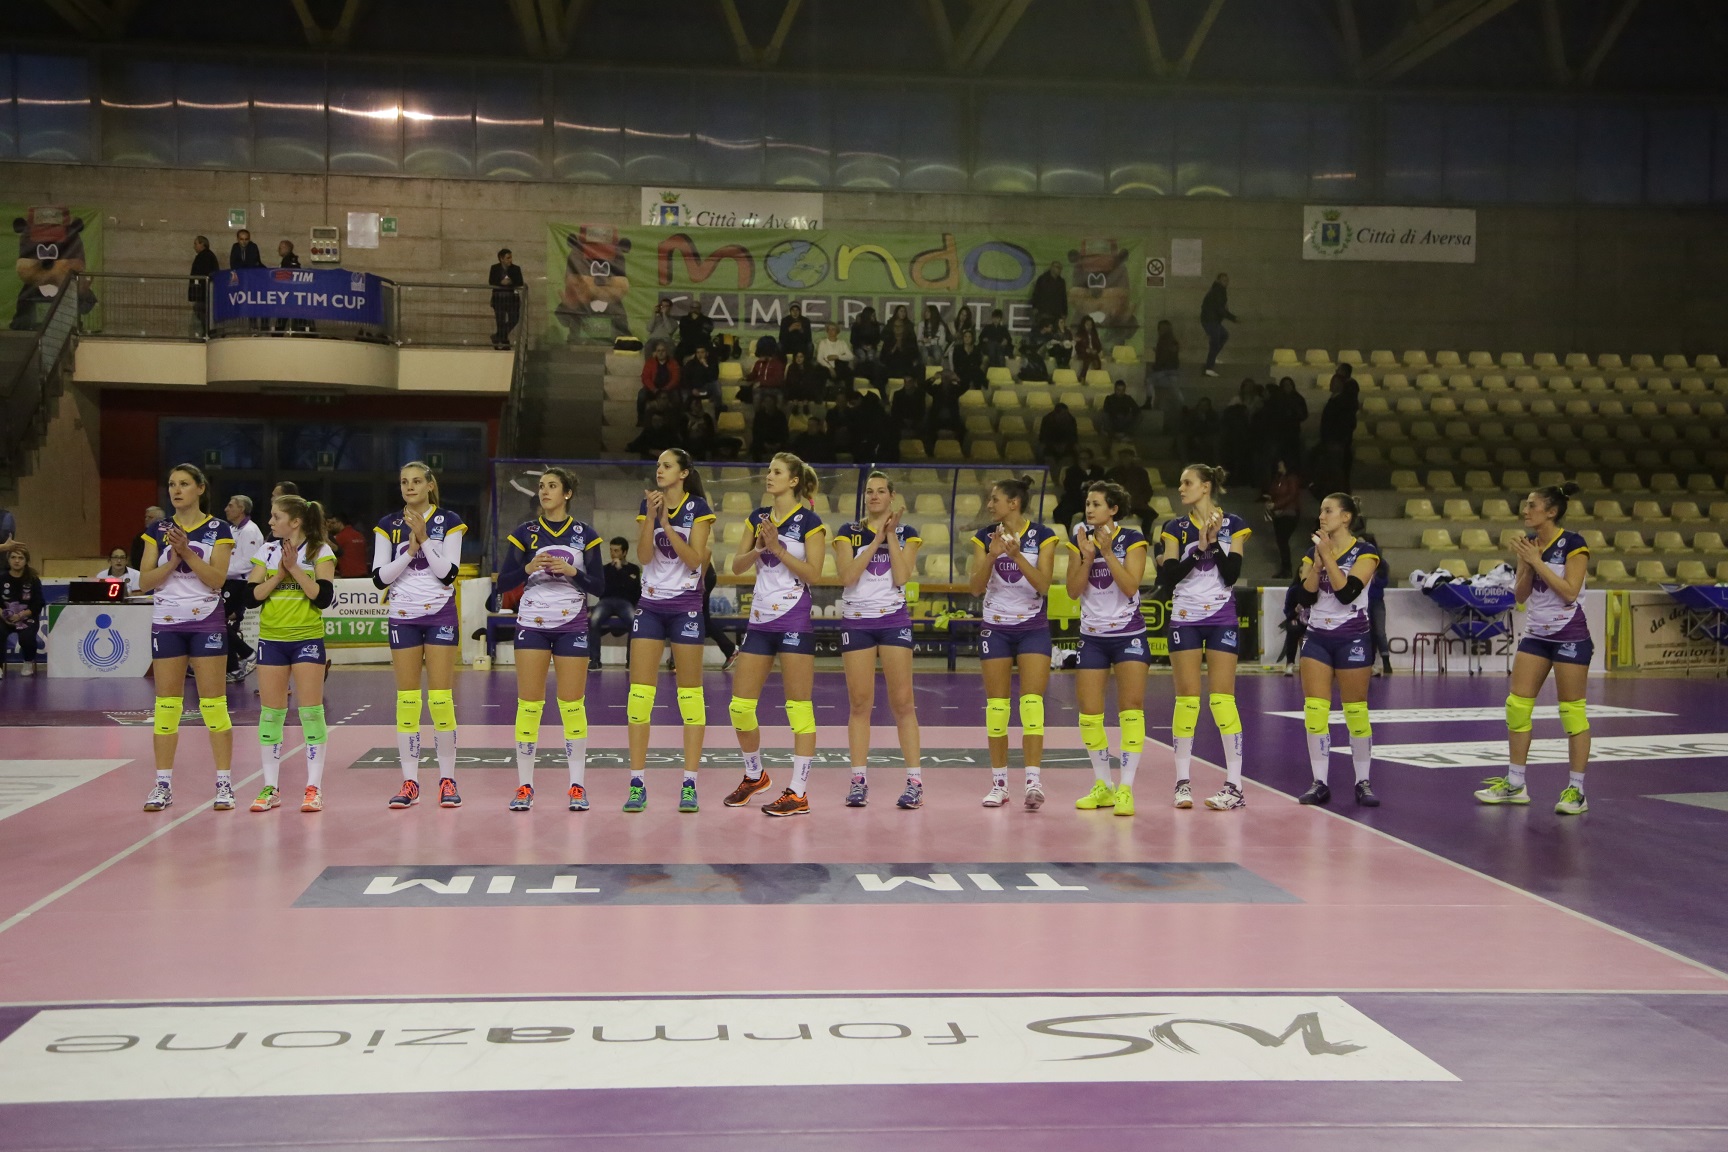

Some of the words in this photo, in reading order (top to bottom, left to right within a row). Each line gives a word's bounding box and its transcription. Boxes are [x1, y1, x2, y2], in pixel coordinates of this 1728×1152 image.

[1356, 227, 1395, 244] Città
[1399, 228, 1416, 244] di
[1419, 229, 1472, 246] Aversa
[292, 271, 313, 282] TIM
[228, 291, 290, 306] VOLLEY
[294, 291, 328, 307] TIM
[331, 294, 366, 310] CUP
[392, 529, 402, 544] 11
[530, 534, 539, 549] 2
[851, 534, 862, 547] 10
[109, 584, 119, 597] 0
[349, 621, 375, 635] 197
[633, 619, 640, 632] 6
[391, 630, 400, 644] 11
[842, 631, 850, 645] 10
[1172, 631, 1181, 644] 9
[153, 637, 159, 652] 4
[981, 640, 990, 653] 8
[258, 646, 263, 661] 1
[362, 875, 600, 894] TIM
[854, 873, 1090, 891] TIM
[45, 1021, 979, 1055] formazione
